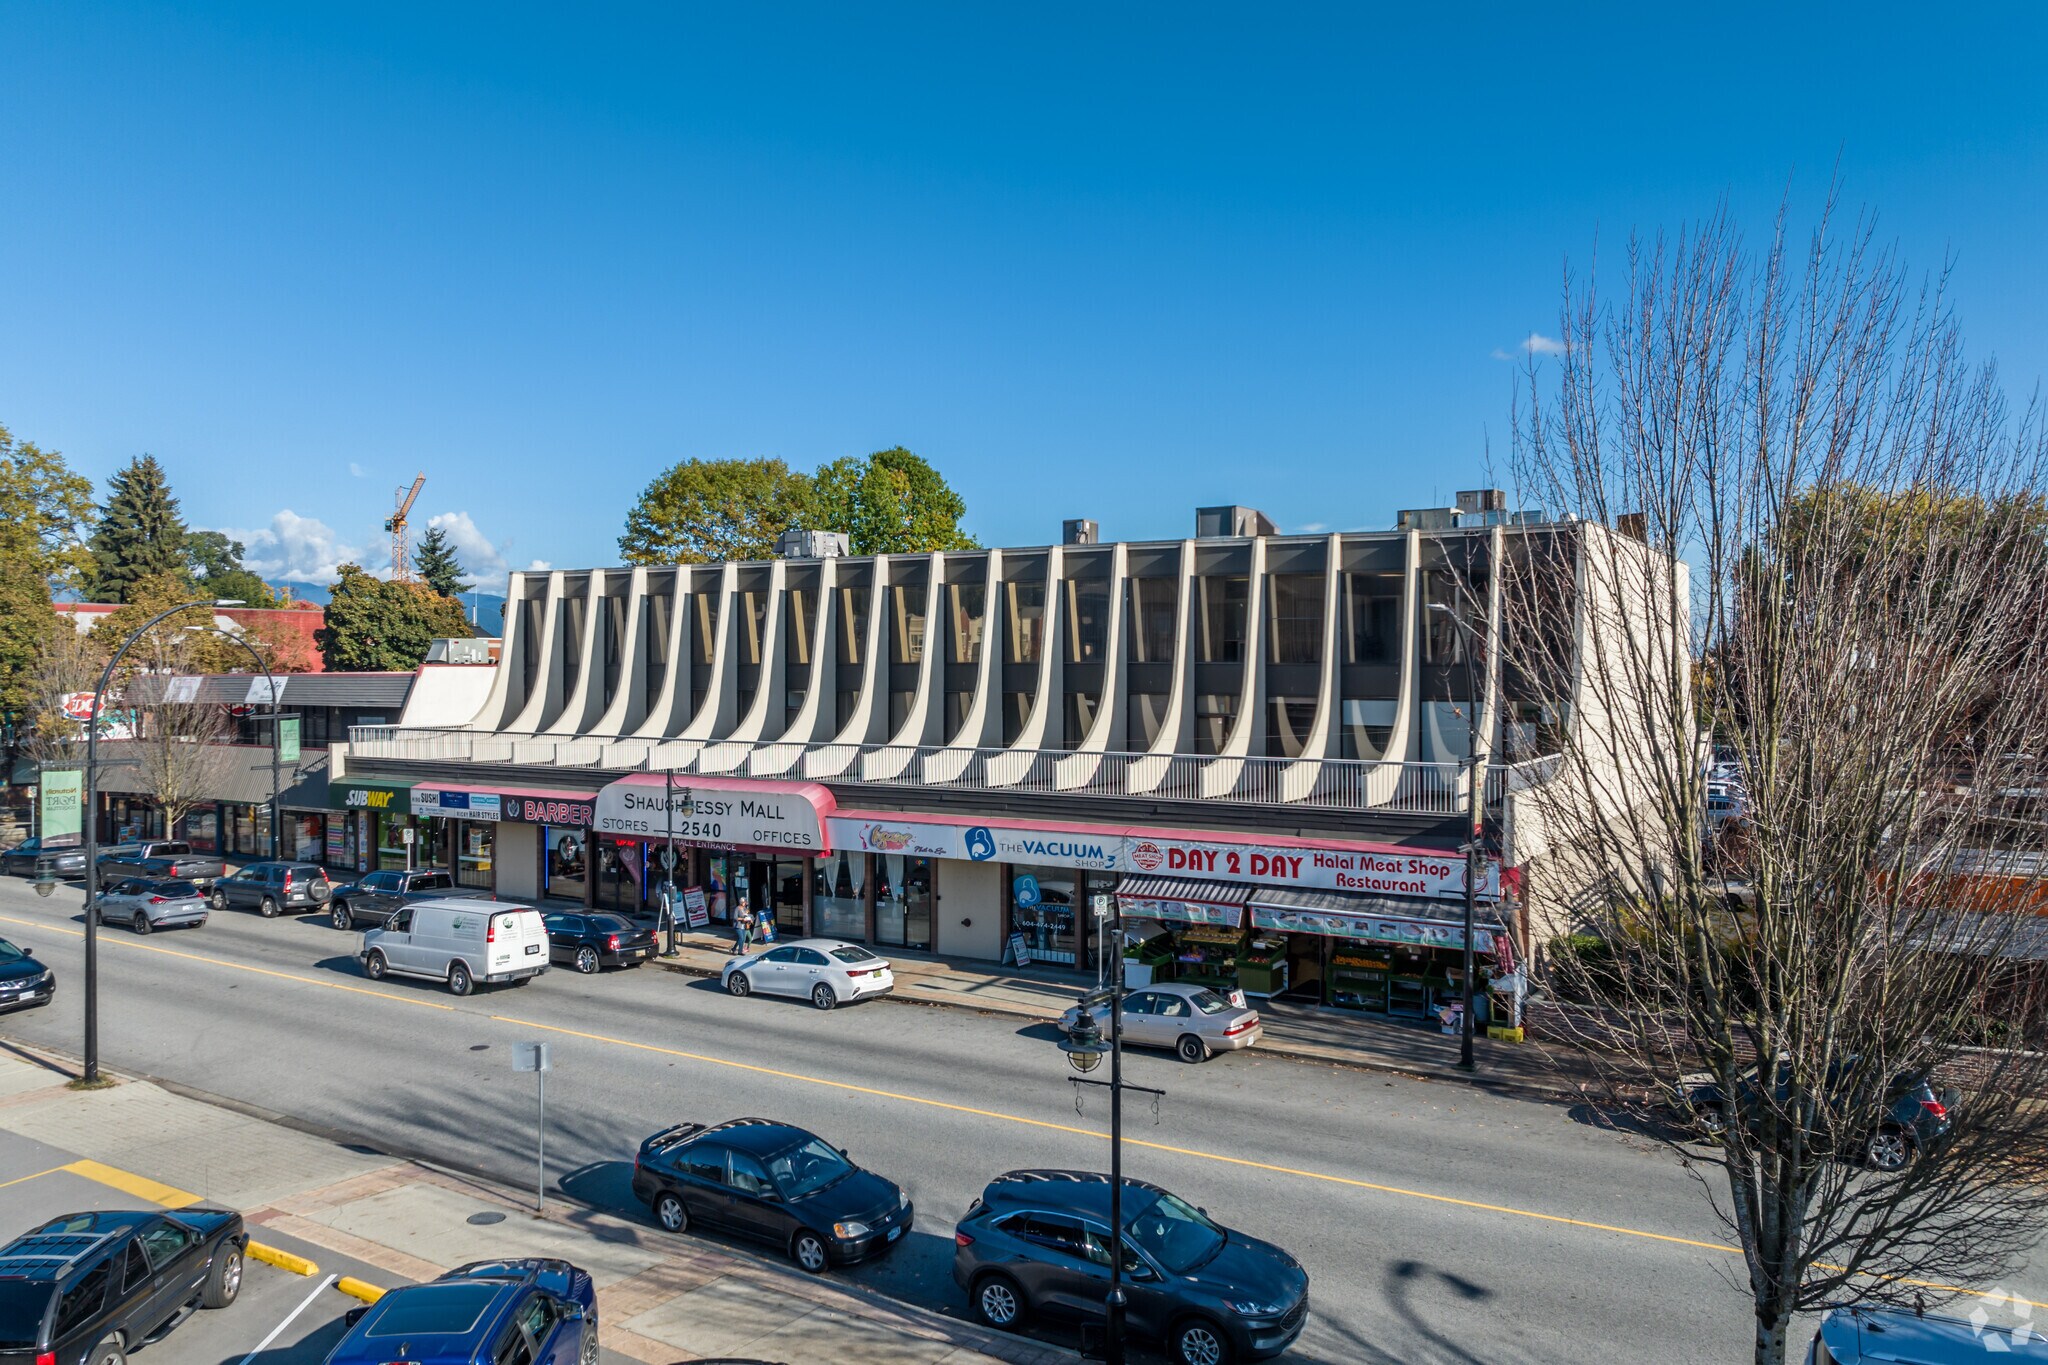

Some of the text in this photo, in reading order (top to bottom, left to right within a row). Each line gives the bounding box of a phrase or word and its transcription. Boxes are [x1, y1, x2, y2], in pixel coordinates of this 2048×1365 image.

[345, 790, 394, 807] SUBWAY
[421, 792, 438, 804] SUSHI
[525, 801, 593, 825] BARBER
[624, 793, 784, 820] SHAUGHESSY MALL
[481, 811, 499, 820] STYLES
[602, 818, 649, 832] STORES
[681, 821, 721, 838] 2540
[674, 839, 736, 851] MALL ENTRANCE
[752, 830, 811, 845] OFFICES
[1000, 840, 1104, 859] THE VACUUM
[1075, 859, 1104, 869] SHOP
[1168, 847, 1304, 879] DAY 2 DAY
[1313, 853, 1450, 880] Halal Meat Shop
[1336, 873, 1426, 893] Restaurant
[1036, 904, 1069, 913] VACUUM
[1022, 920, 1066, 930] 604-474-2449
